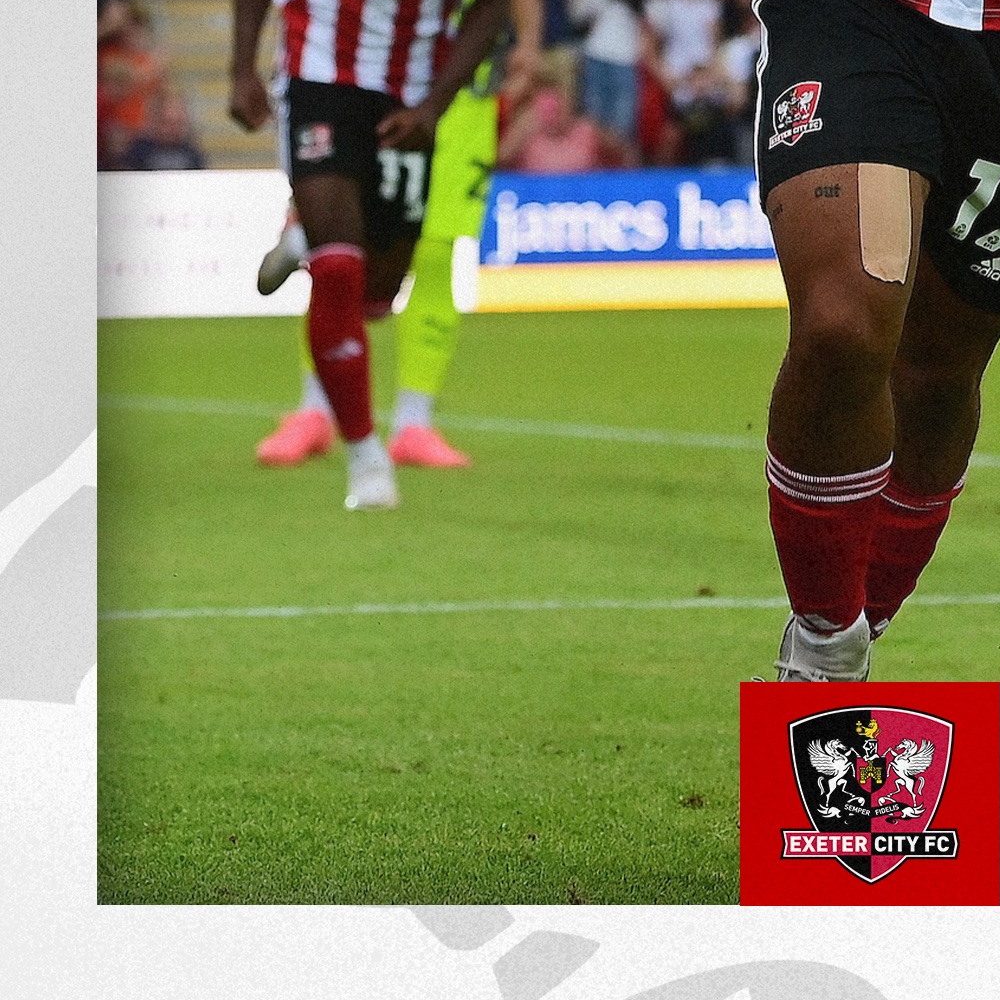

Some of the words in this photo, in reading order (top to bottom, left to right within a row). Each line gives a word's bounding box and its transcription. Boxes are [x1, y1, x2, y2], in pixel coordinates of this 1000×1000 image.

[792, 123, 808, 134] CITY
[809, 120, 819, 129] FC
[815, 183, 840, 198] out
[485, 190, 670, 268] james
[677, 181, 774, 251] hal
